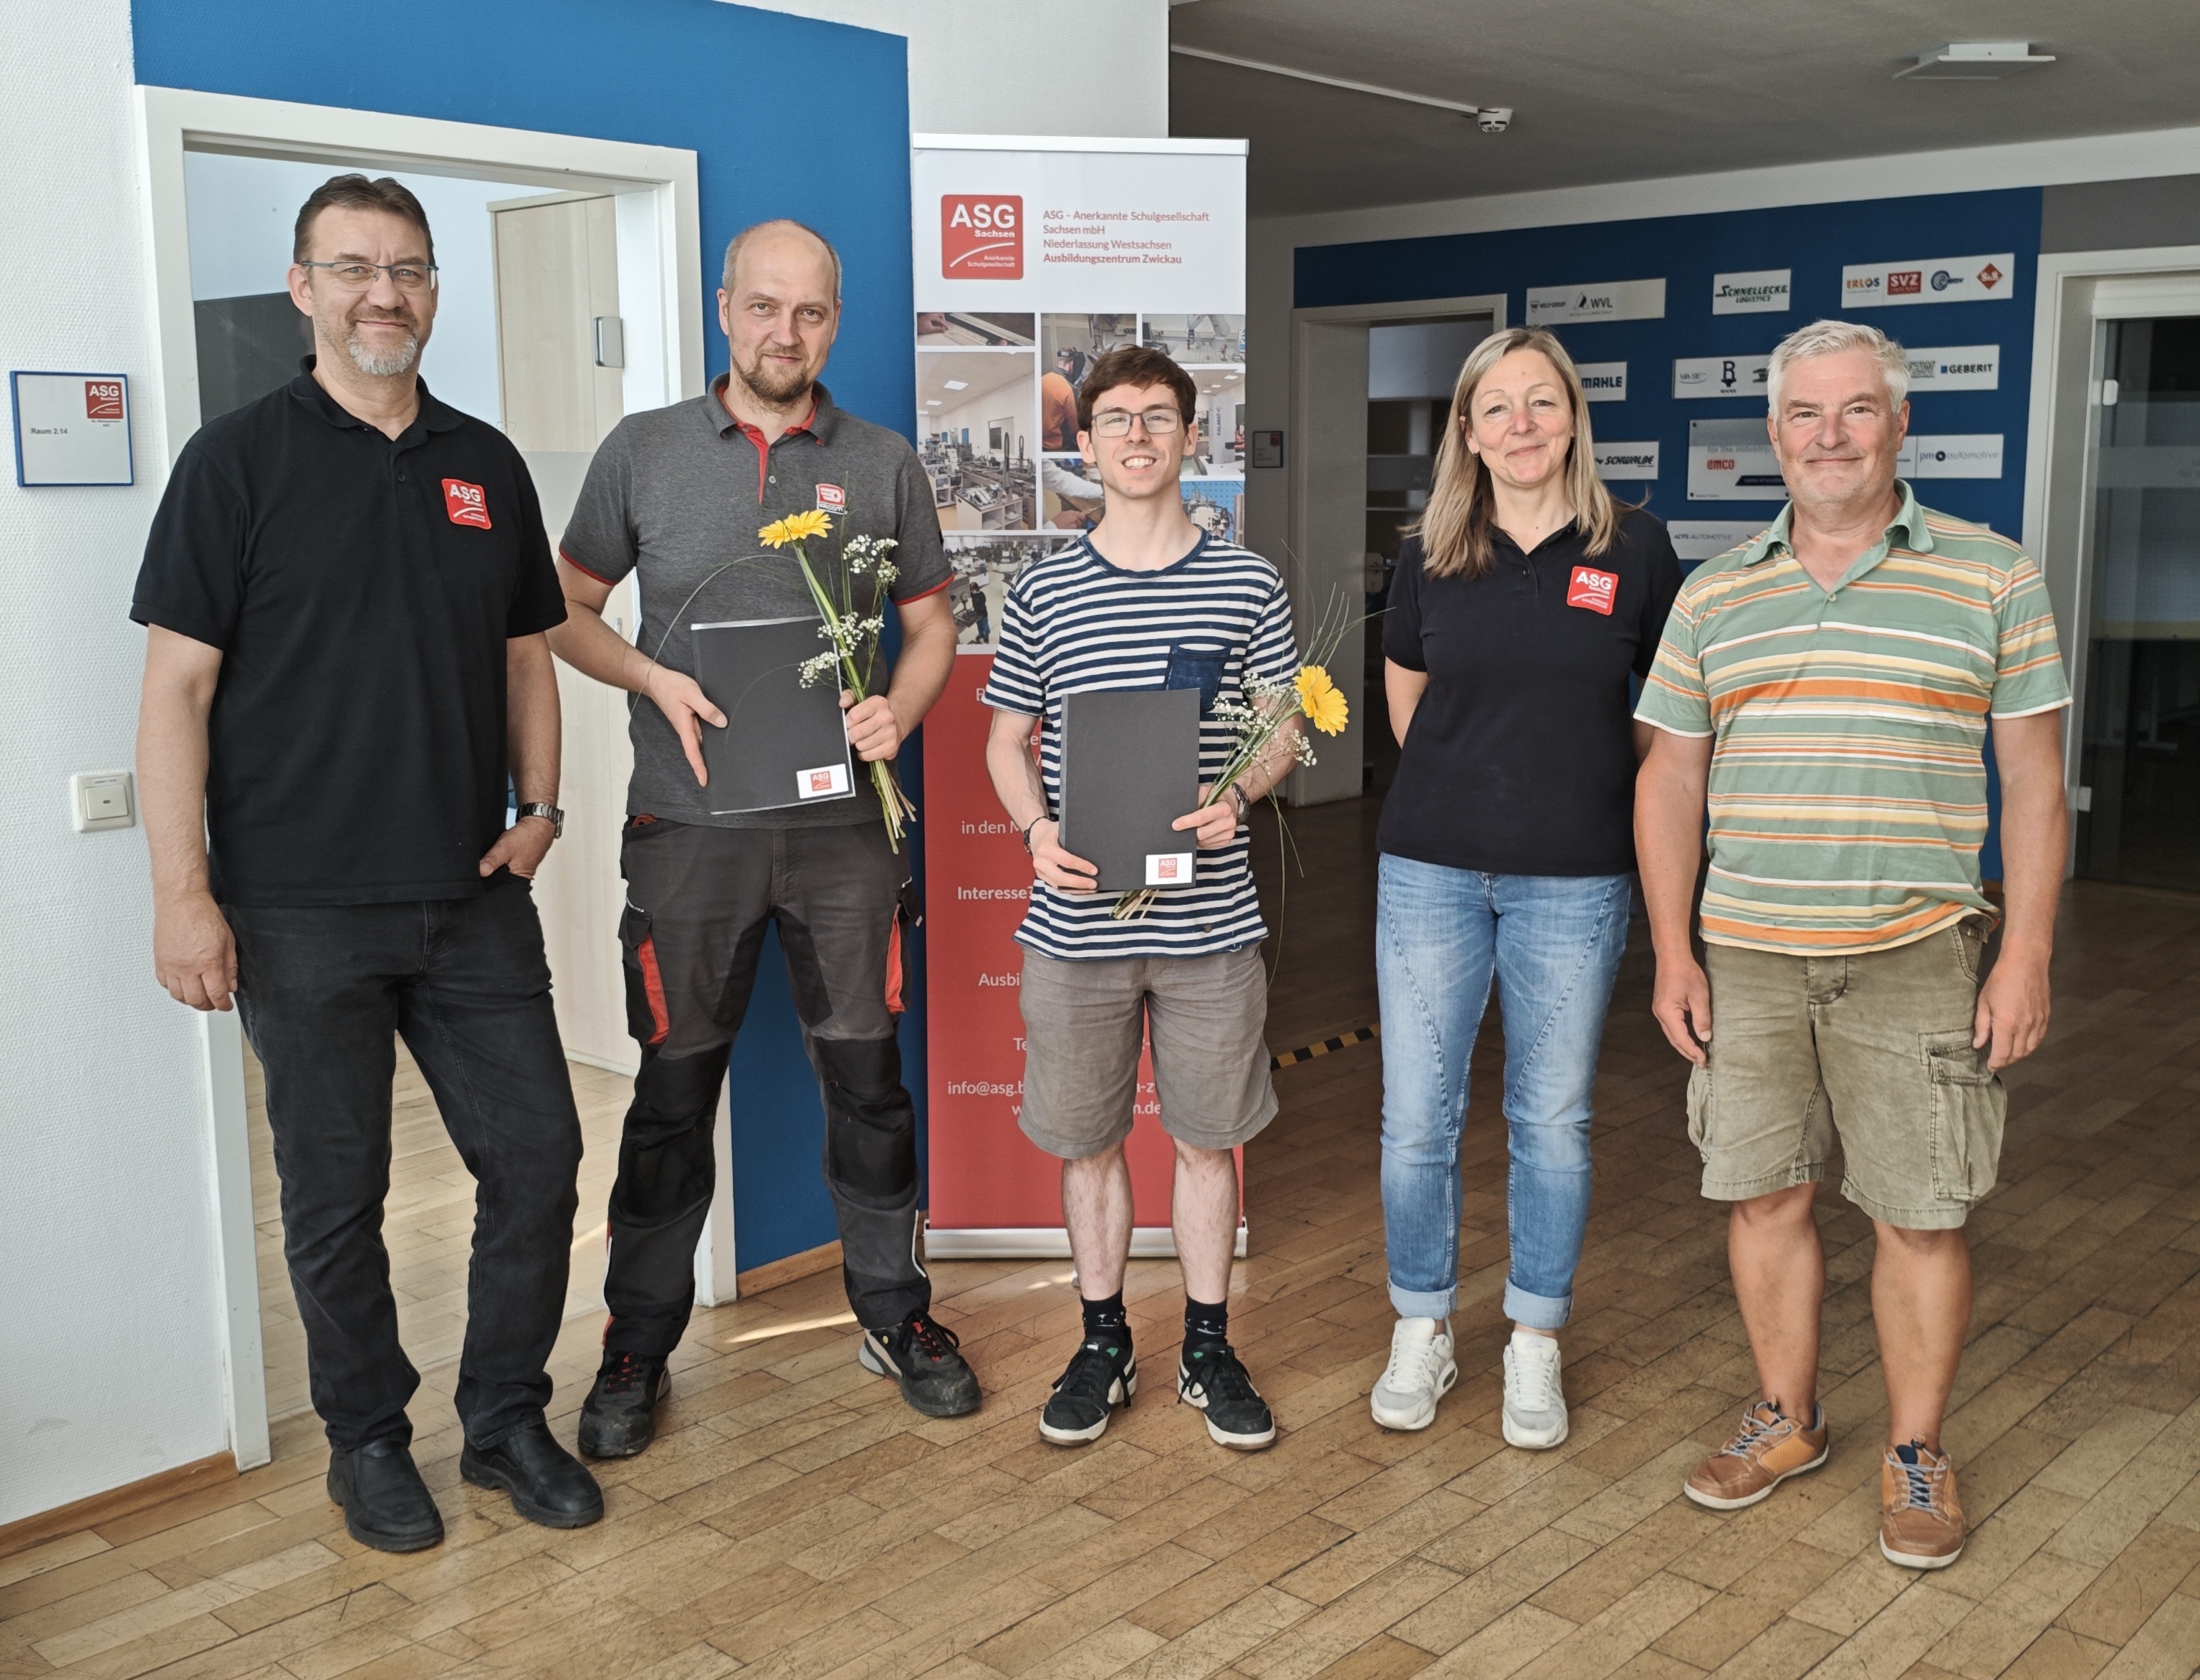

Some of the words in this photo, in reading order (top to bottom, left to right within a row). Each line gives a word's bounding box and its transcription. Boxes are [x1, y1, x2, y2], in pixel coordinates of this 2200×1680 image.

[949, 203, 1015, 229] ASG
[1043, 210, 1064, 220] ASG
[1073, 211, 1128, 221] Anerkannte
[1130, 211, 1210, 223] Schulgesellschaft
[974, 229, 1015, 238] Sachsen
[1043, 224, 1081, 234] Sachsen
[1082, 225, 1105, 235] mbH
[1043, 239, 1110, 251] Niederlassung
[1110, 239, 1172, 249] Westsachsen
[1043, 253, 1140, 264] Ausbildungszentrum
[1142, 254, 1182, 264] Zwickau
[1889, 274, 1921, 287] SVZ
[1590, 297, 1614, 309] WVL
[1949, 363, 1994, 375] GEBERIT
[1580, 375, 1623, 389] MAHLE
[89, 385, 120, 397] ASG
[449, 484, 481, 502] ASG
[1576, 571, 1613, 590] ASG
[812, 772, 830, 782] ASG
[961, 820, 975, 834] in
[978, 820, 1006, 834] den
[978, 972, 1020, 987] Ausbi
[947, 1080, 1024, 1097] info@asg.b
